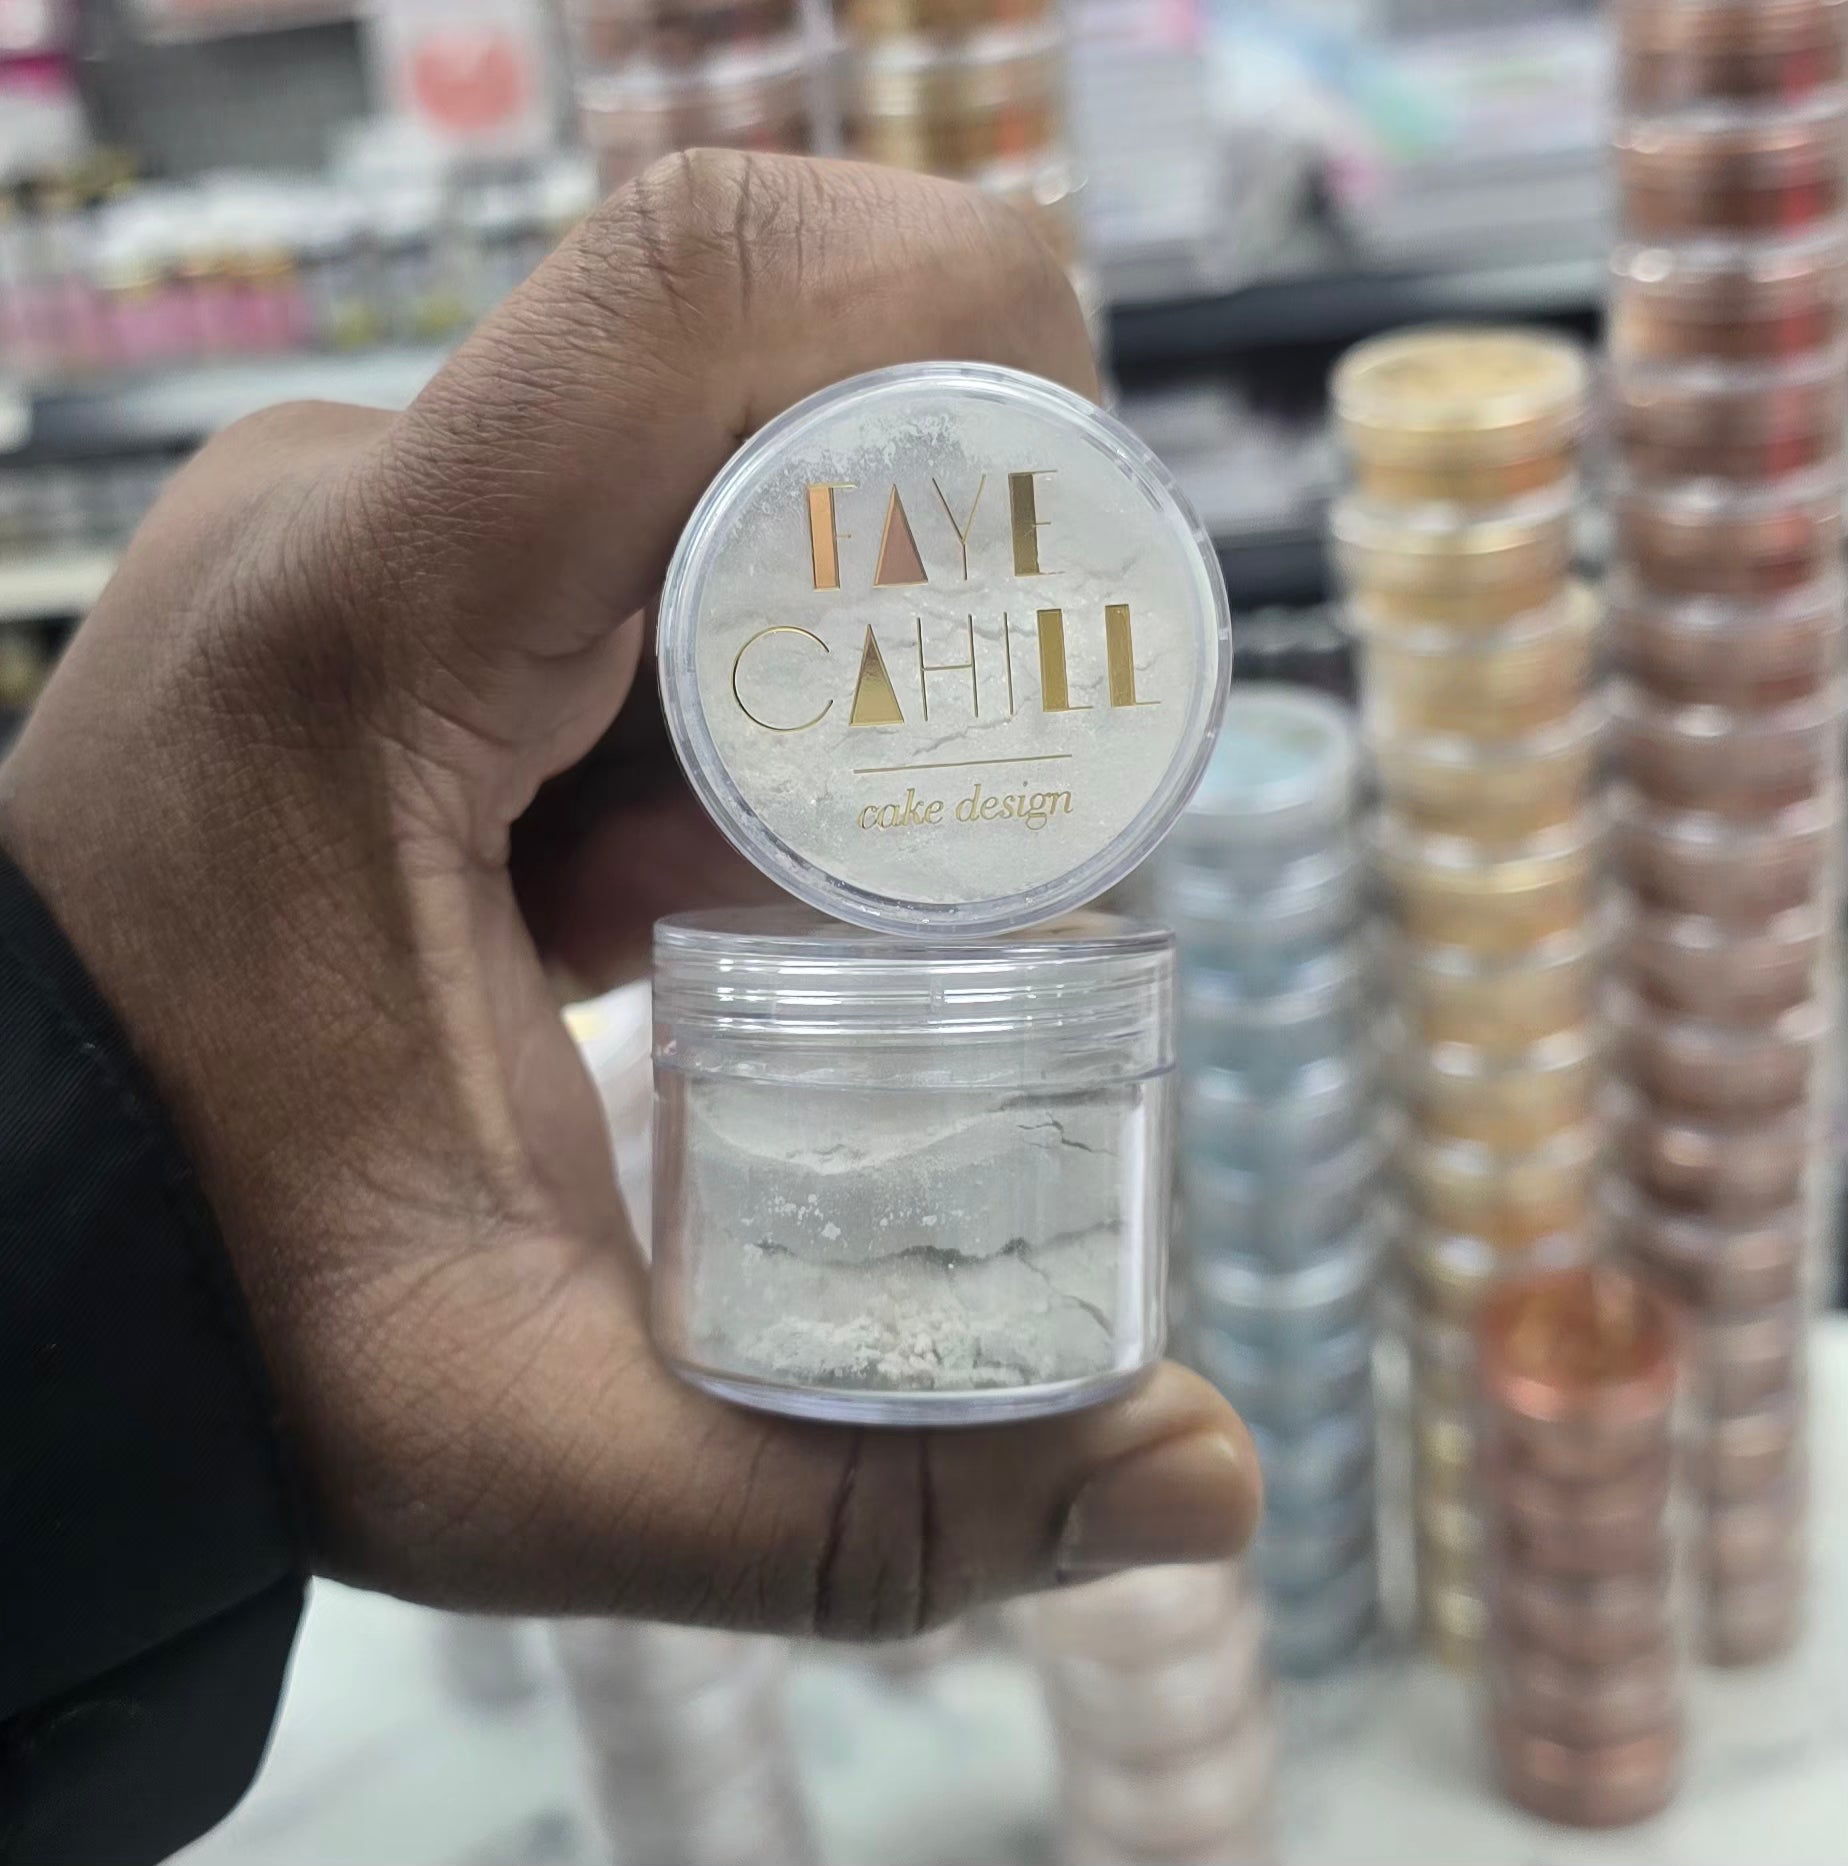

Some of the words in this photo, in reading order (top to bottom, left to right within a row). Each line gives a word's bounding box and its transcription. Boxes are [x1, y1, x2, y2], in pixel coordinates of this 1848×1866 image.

[806, 469, 1066, 591] FAYE
[730, 603, 1162, 733] CAHILL
[857, 788, 944, 831] cake
[955, 781, 1073, 831] design
